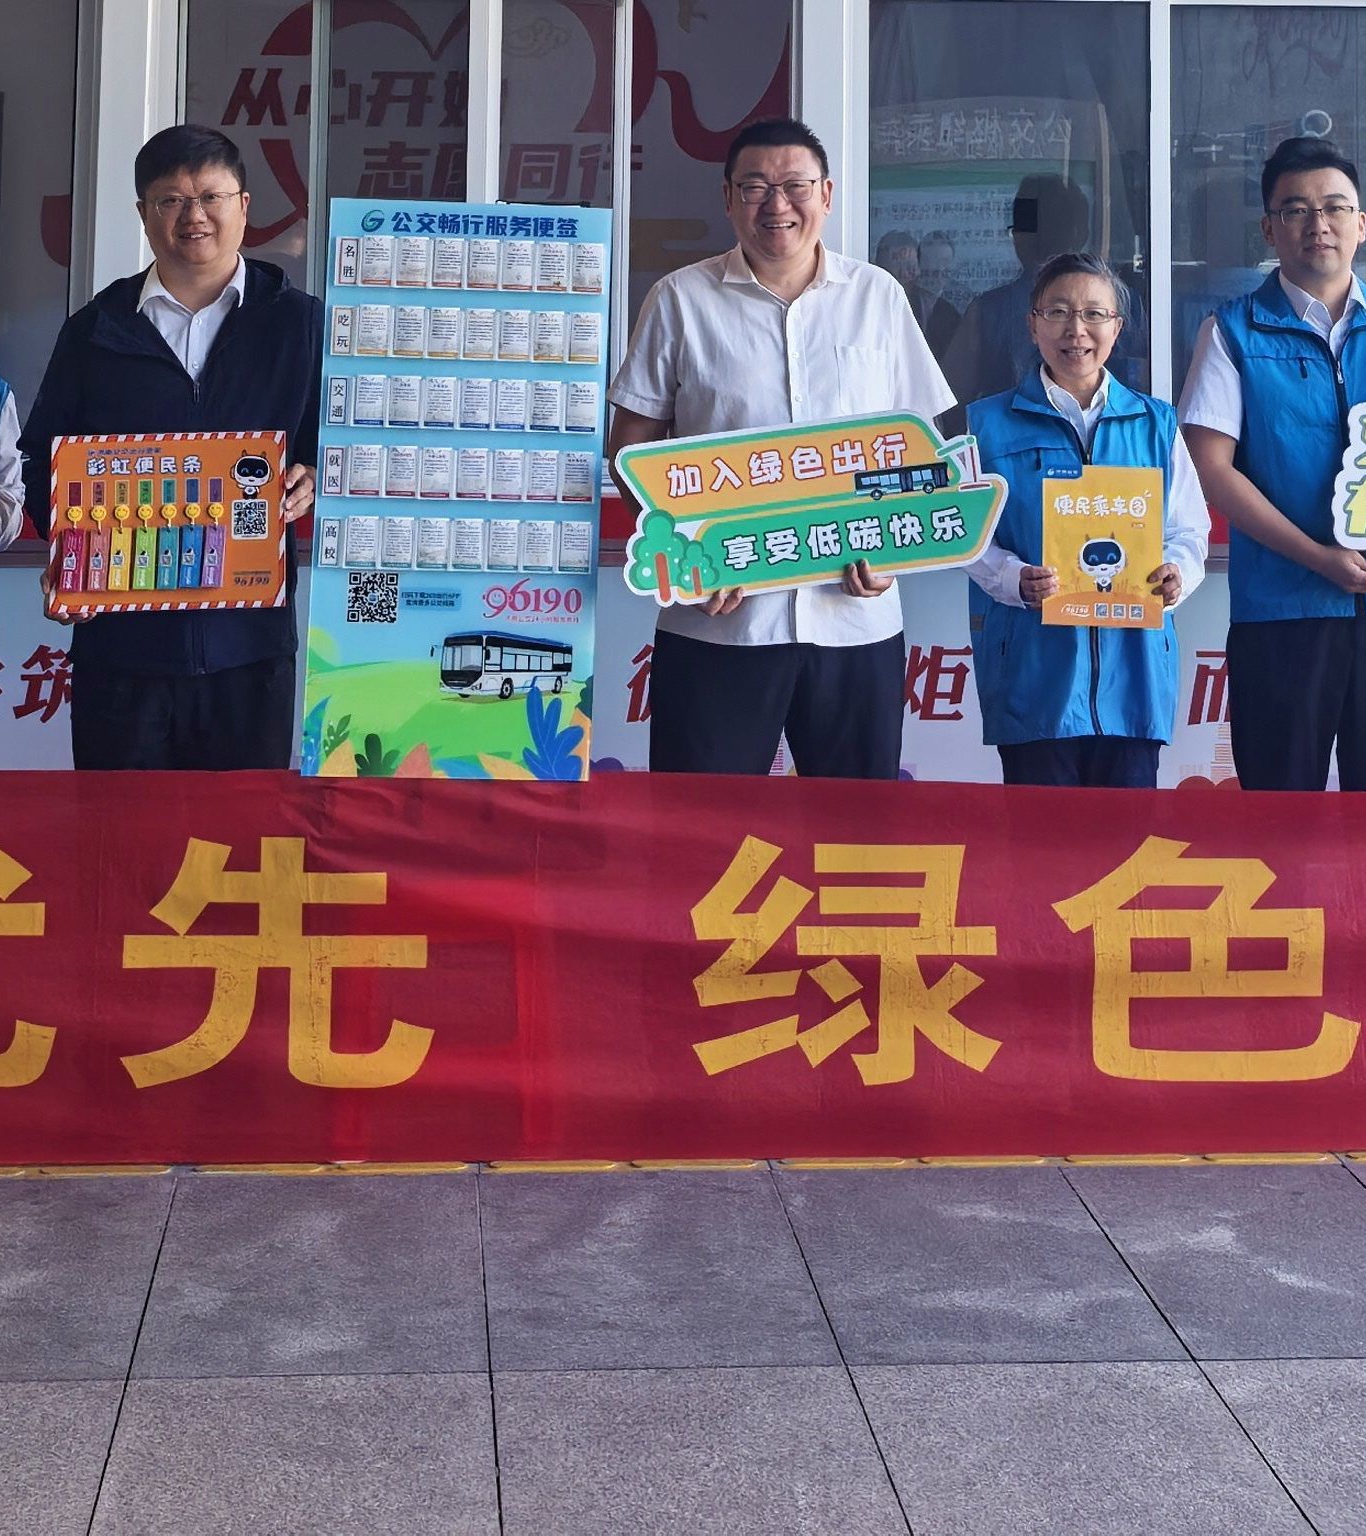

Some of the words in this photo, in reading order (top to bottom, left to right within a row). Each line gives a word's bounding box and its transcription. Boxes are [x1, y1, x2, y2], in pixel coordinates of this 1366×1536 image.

[391, 210, 579, 239] 公交畅行服务便签
[342, 244, 356, 278] 名胜
[336, 314, 350, 348] 吃玩
[330, 385, 344, 418] 交通
[86, 456, 204, 476] 彩虹便民条
[327, 454, 341, 488] 就医
[666, 432, 908, 499] 加入绿色出行
[323, 525, 337, 560] 高校
[722, 507, 968, 571] 享受低碳快乐
[482, 578, 583, 619] 96190
